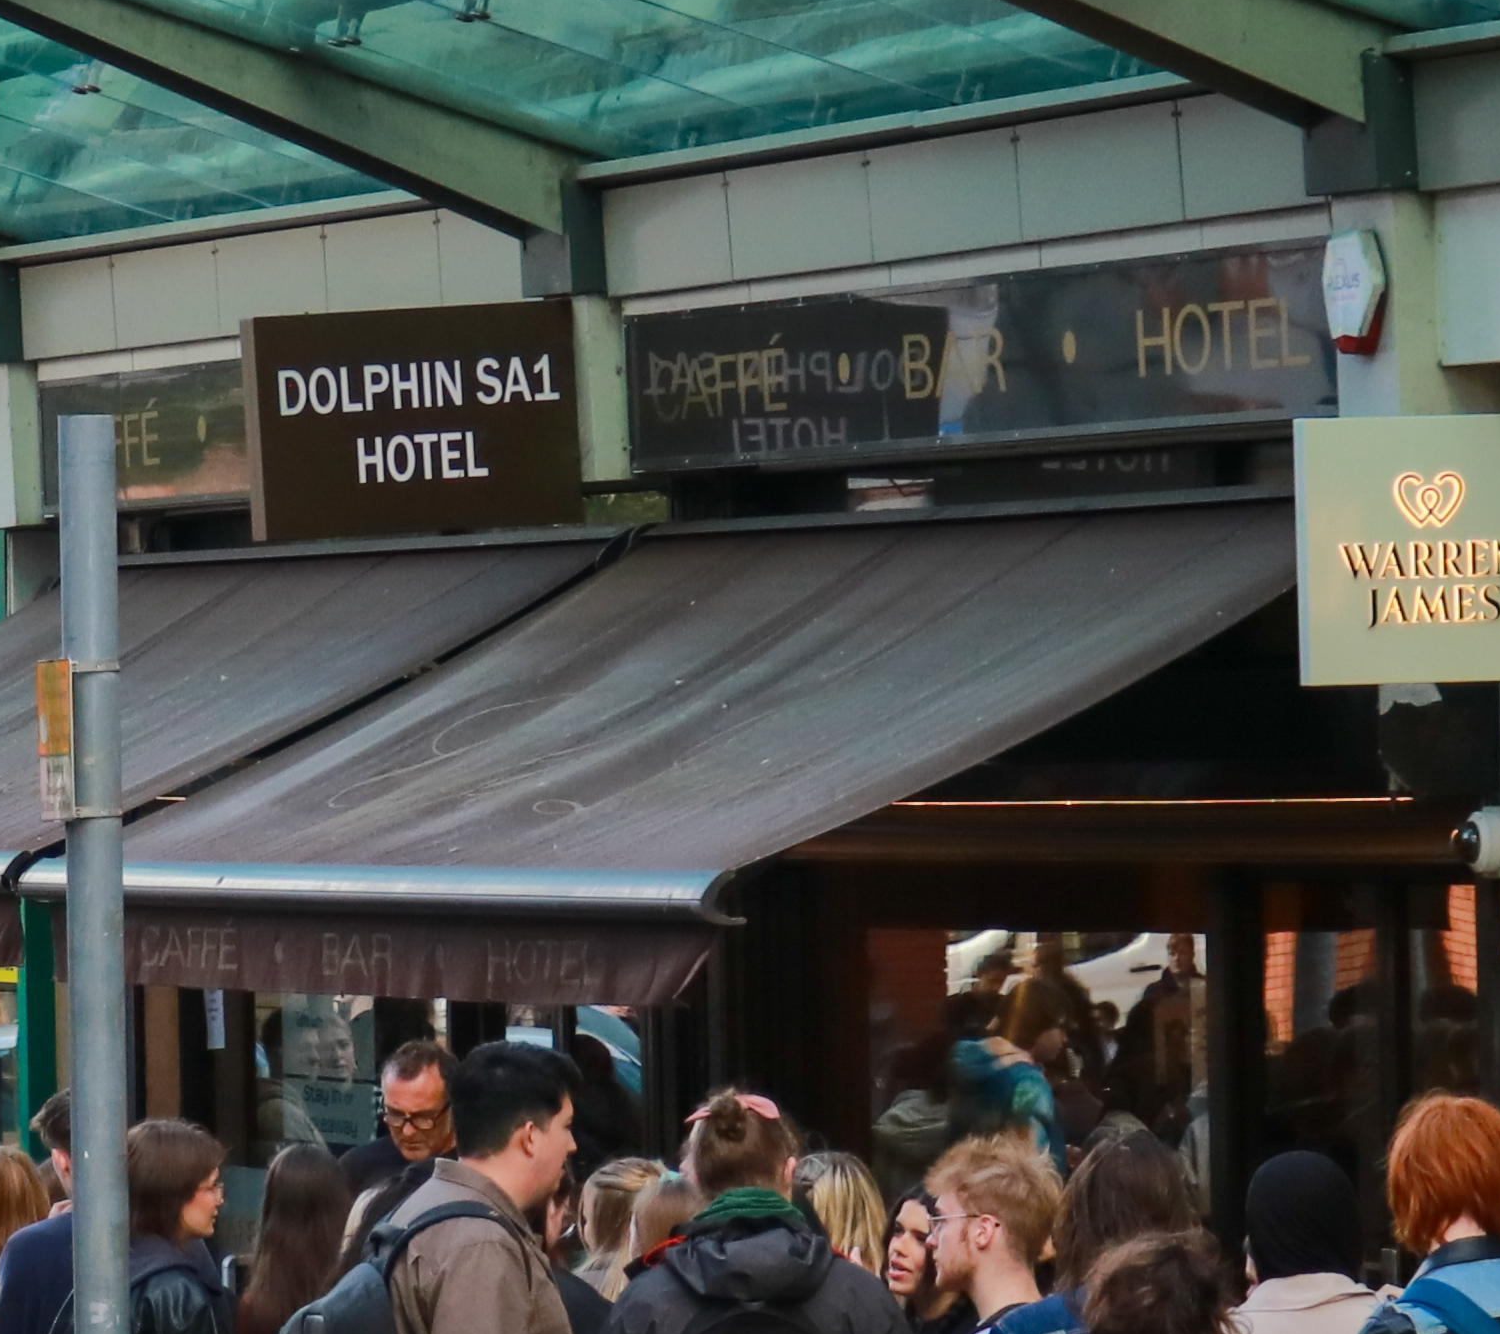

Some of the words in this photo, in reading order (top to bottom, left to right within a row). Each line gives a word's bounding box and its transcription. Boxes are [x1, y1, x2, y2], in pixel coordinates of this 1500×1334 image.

[902, 327, 1007, 400] BAR
[1136, 297, 1311, 378] HOTEL
[277, 358, 463, 417] DOLPHIN
[475, 353, 560, 406] SA1
[356, 431, 489, 484] HOTEL
[140, 922, 238, 971] CAFFÉ
[321, 931, 392, 978] BAR
[303, 1085, 329, 1104] Stay
